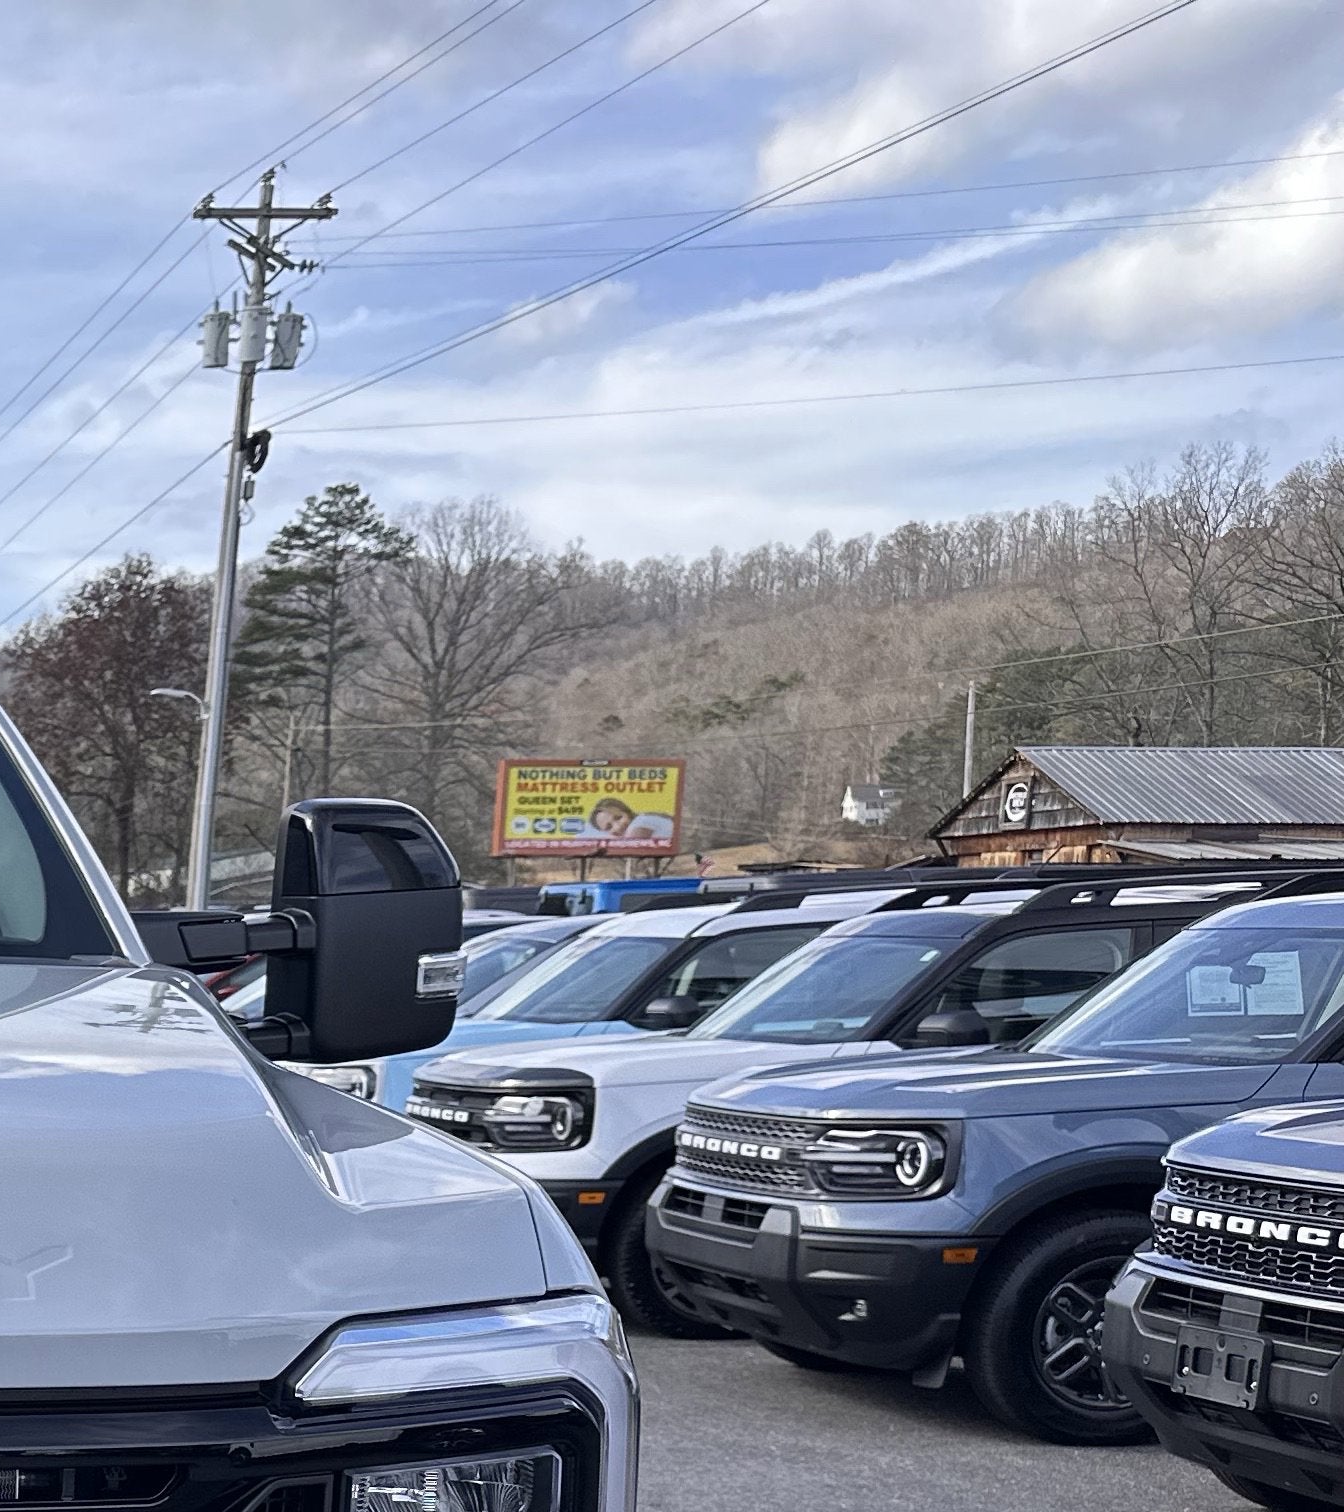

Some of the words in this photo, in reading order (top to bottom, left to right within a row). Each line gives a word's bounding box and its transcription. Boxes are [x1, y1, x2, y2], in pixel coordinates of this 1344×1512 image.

[517, 769, 588, 781] NOTHING
[592, 769, 624, 781] BUT
[628, 769, 668, 781] BEDS
[516, 782, 600, 793] MATTRESS
[604, 782, 667, 793] OUTLET
[517, 796, 557, 805] QUEEN
[560, 796, 581, 805] SET
[680, 1132, 782, 1160] BRONCO
[1170, 1205, 1344, 1249] BRONC
